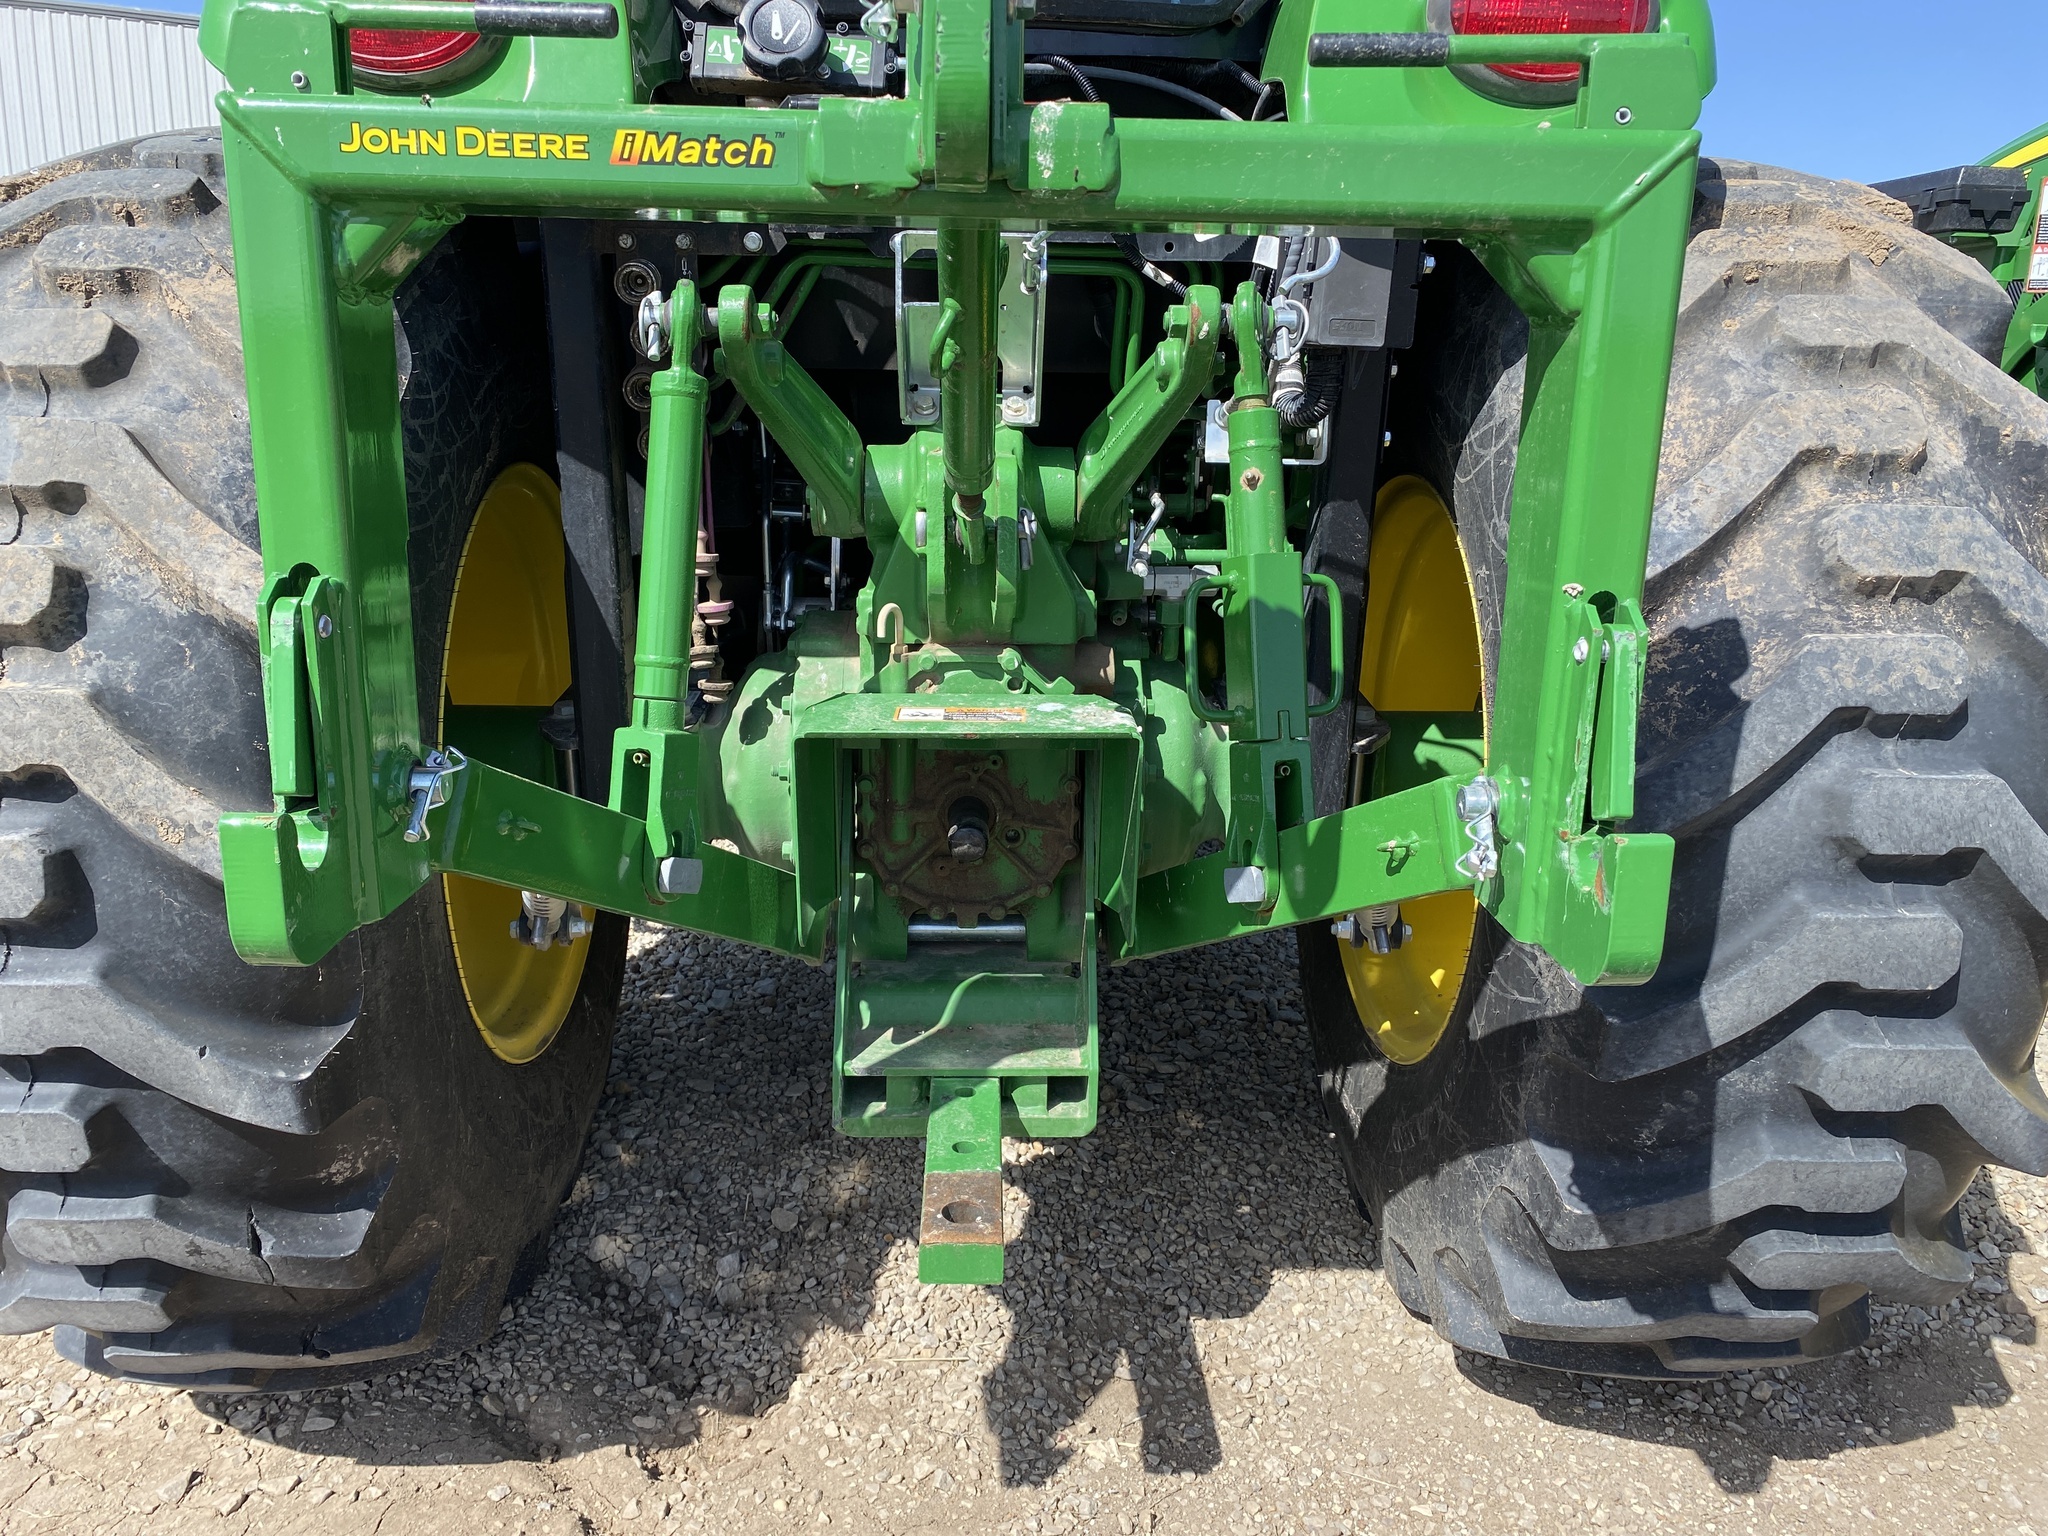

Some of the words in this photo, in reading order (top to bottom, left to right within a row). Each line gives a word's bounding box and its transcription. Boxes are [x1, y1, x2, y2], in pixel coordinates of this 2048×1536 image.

[340, 122, 447, 156] JOHN
[455, 125, 590, 160] DEERE
[610, 129, 776, 168] iMatch
